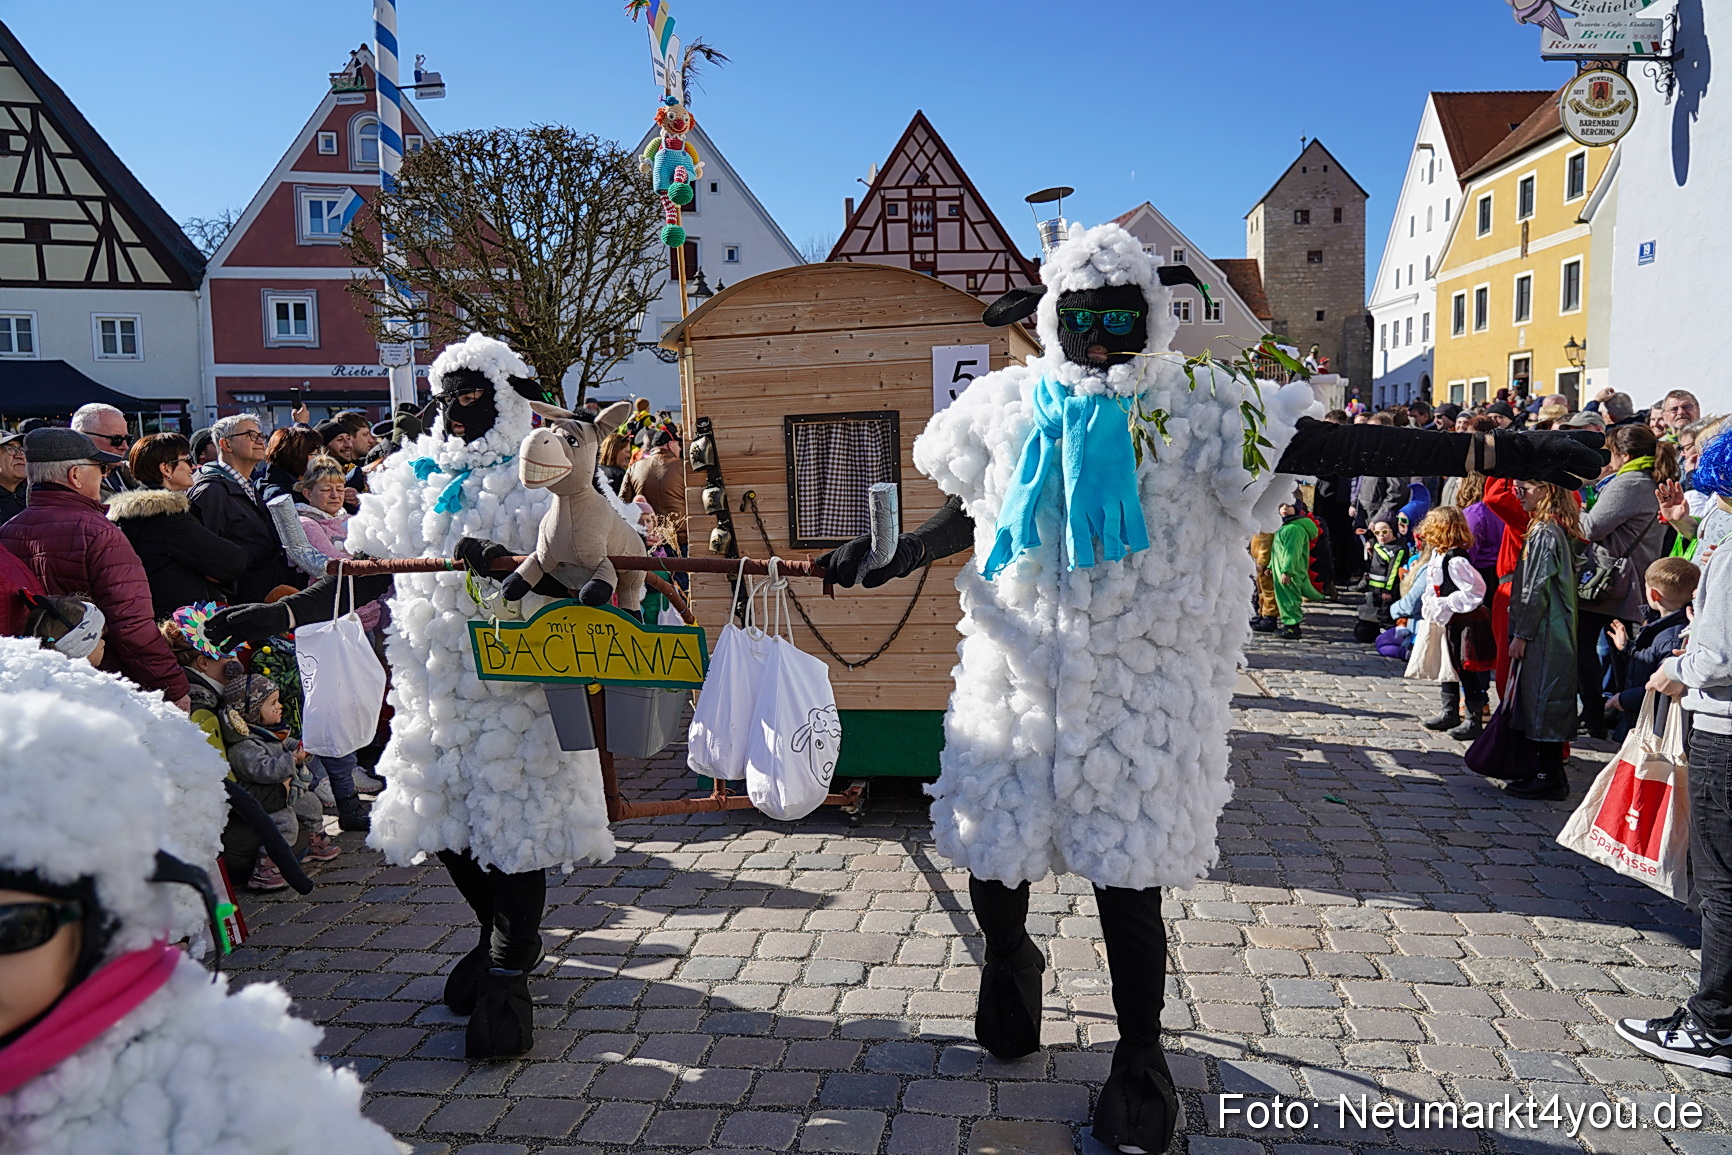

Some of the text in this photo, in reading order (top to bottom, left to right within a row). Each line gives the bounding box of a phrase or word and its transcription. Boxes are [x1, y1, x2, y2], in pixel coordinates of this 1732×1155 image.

[1570, 0, 1637, 14] Eisdiele
[1580, 30, 1626, 40] Bella
[1548, 40, 1598, 49] Roma
[331, 365, 373, 376] Riebe
[547, 616, 618, 636] mir san
[483, 632, 702, 678] BACHAMA
[1590, 829, 1657, 876] Sparkasse
